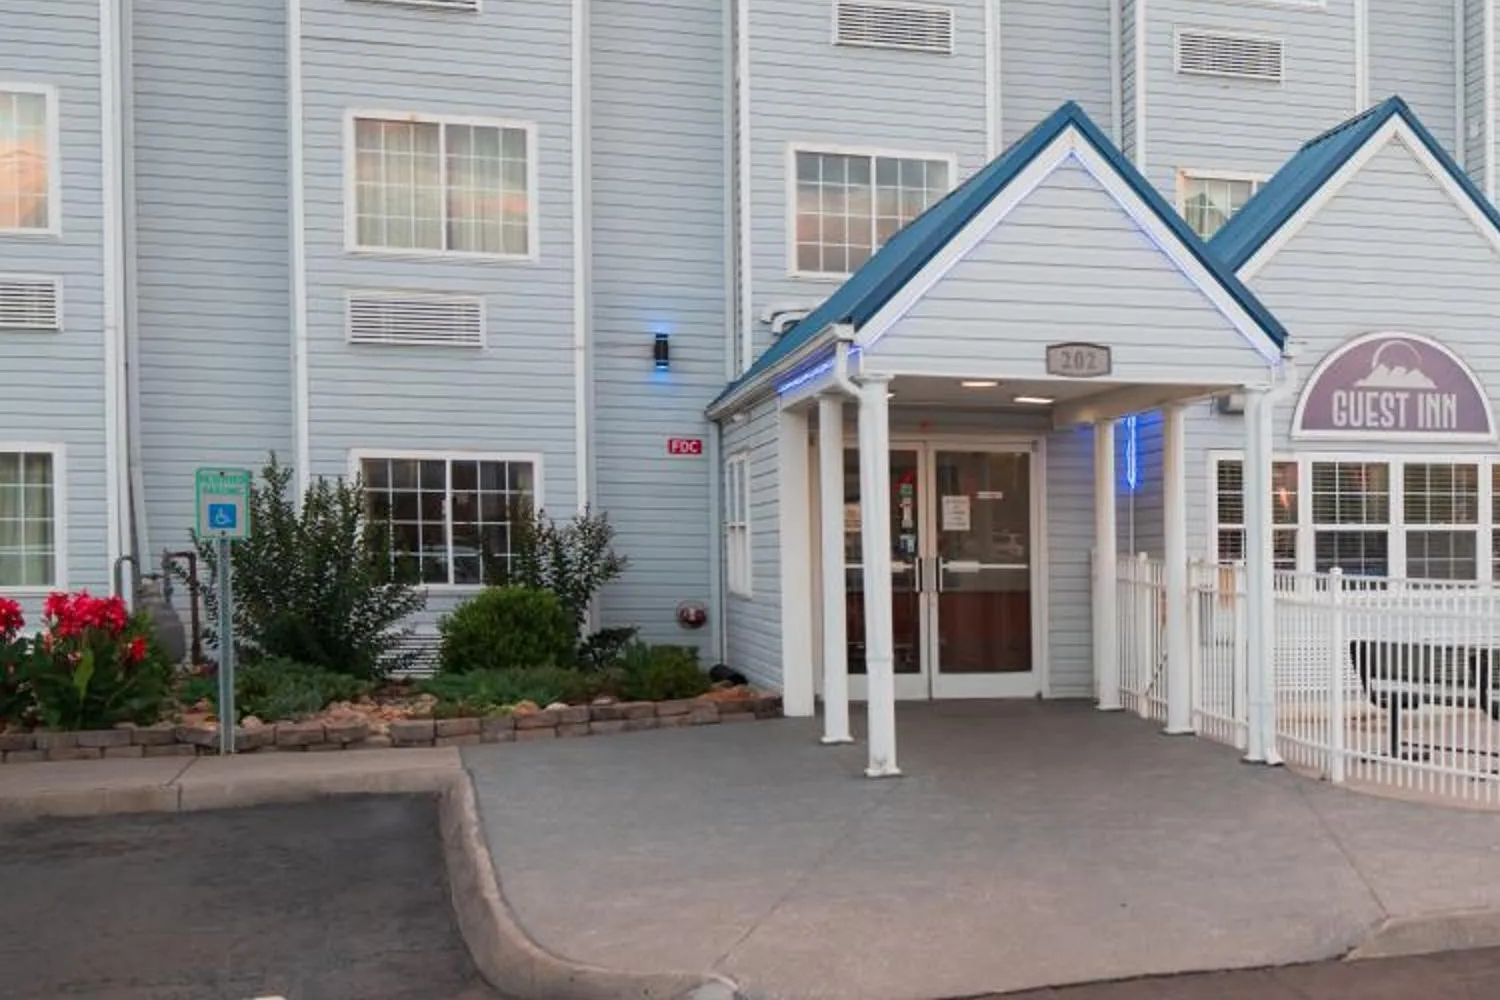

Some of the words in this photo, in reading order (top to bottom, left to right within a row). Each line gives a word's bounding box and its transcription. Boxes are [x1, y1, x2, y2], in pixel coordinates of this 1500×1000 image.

[1061, 350, 1098, 370] 202
[1332, 389, 1410, 429] GUEST
[1417, 392, 1458, 429] INN
[671, 440, 700, 454] FDC
